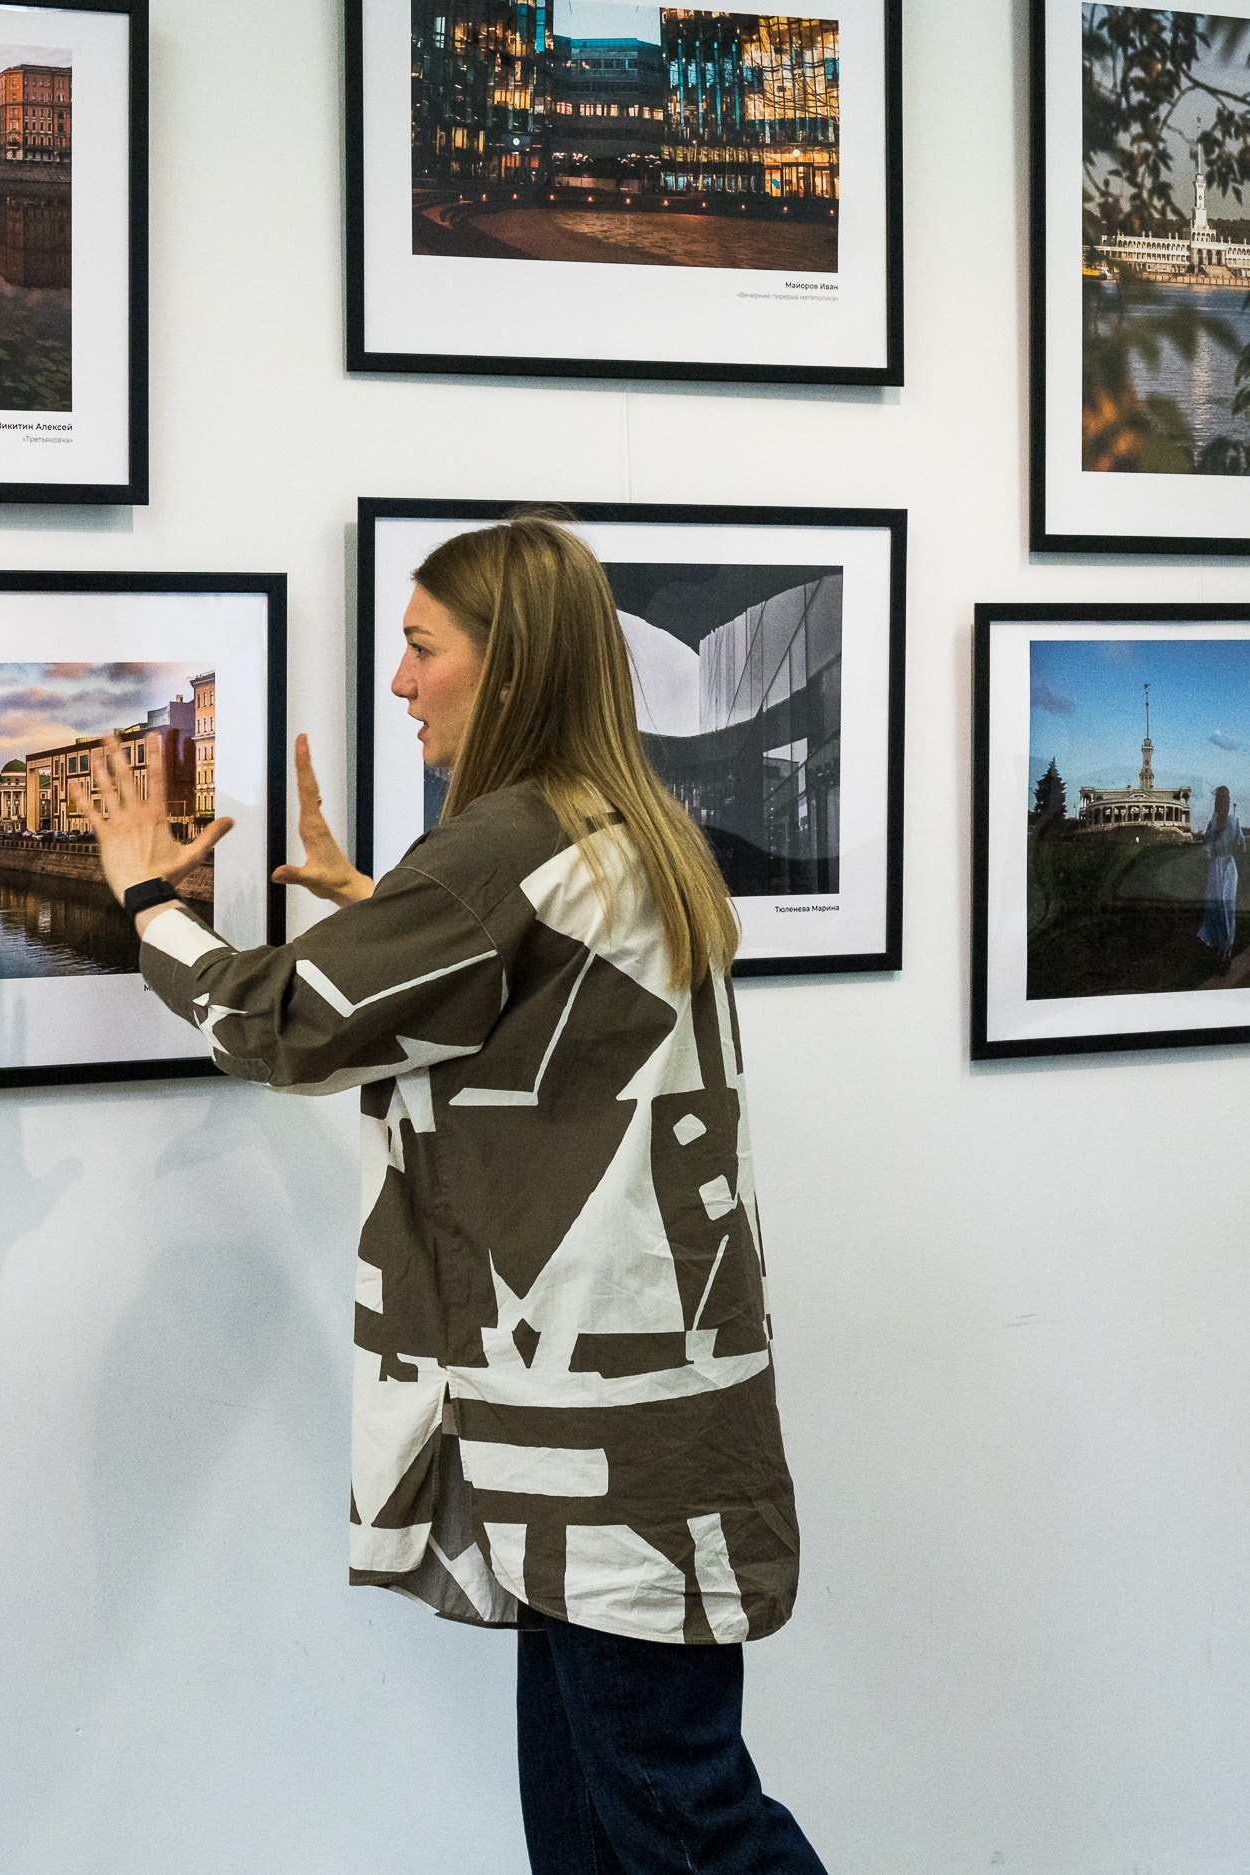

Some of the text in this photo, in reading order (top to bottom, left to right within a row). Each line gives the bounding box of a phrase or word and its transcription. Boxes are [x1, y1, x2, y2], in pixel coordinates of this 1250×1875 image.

[785, 281, 818, 290] Майоров
[35, 423, 73, 431] Алексей
[22, 435, 73, 443] «Третьяковка»
